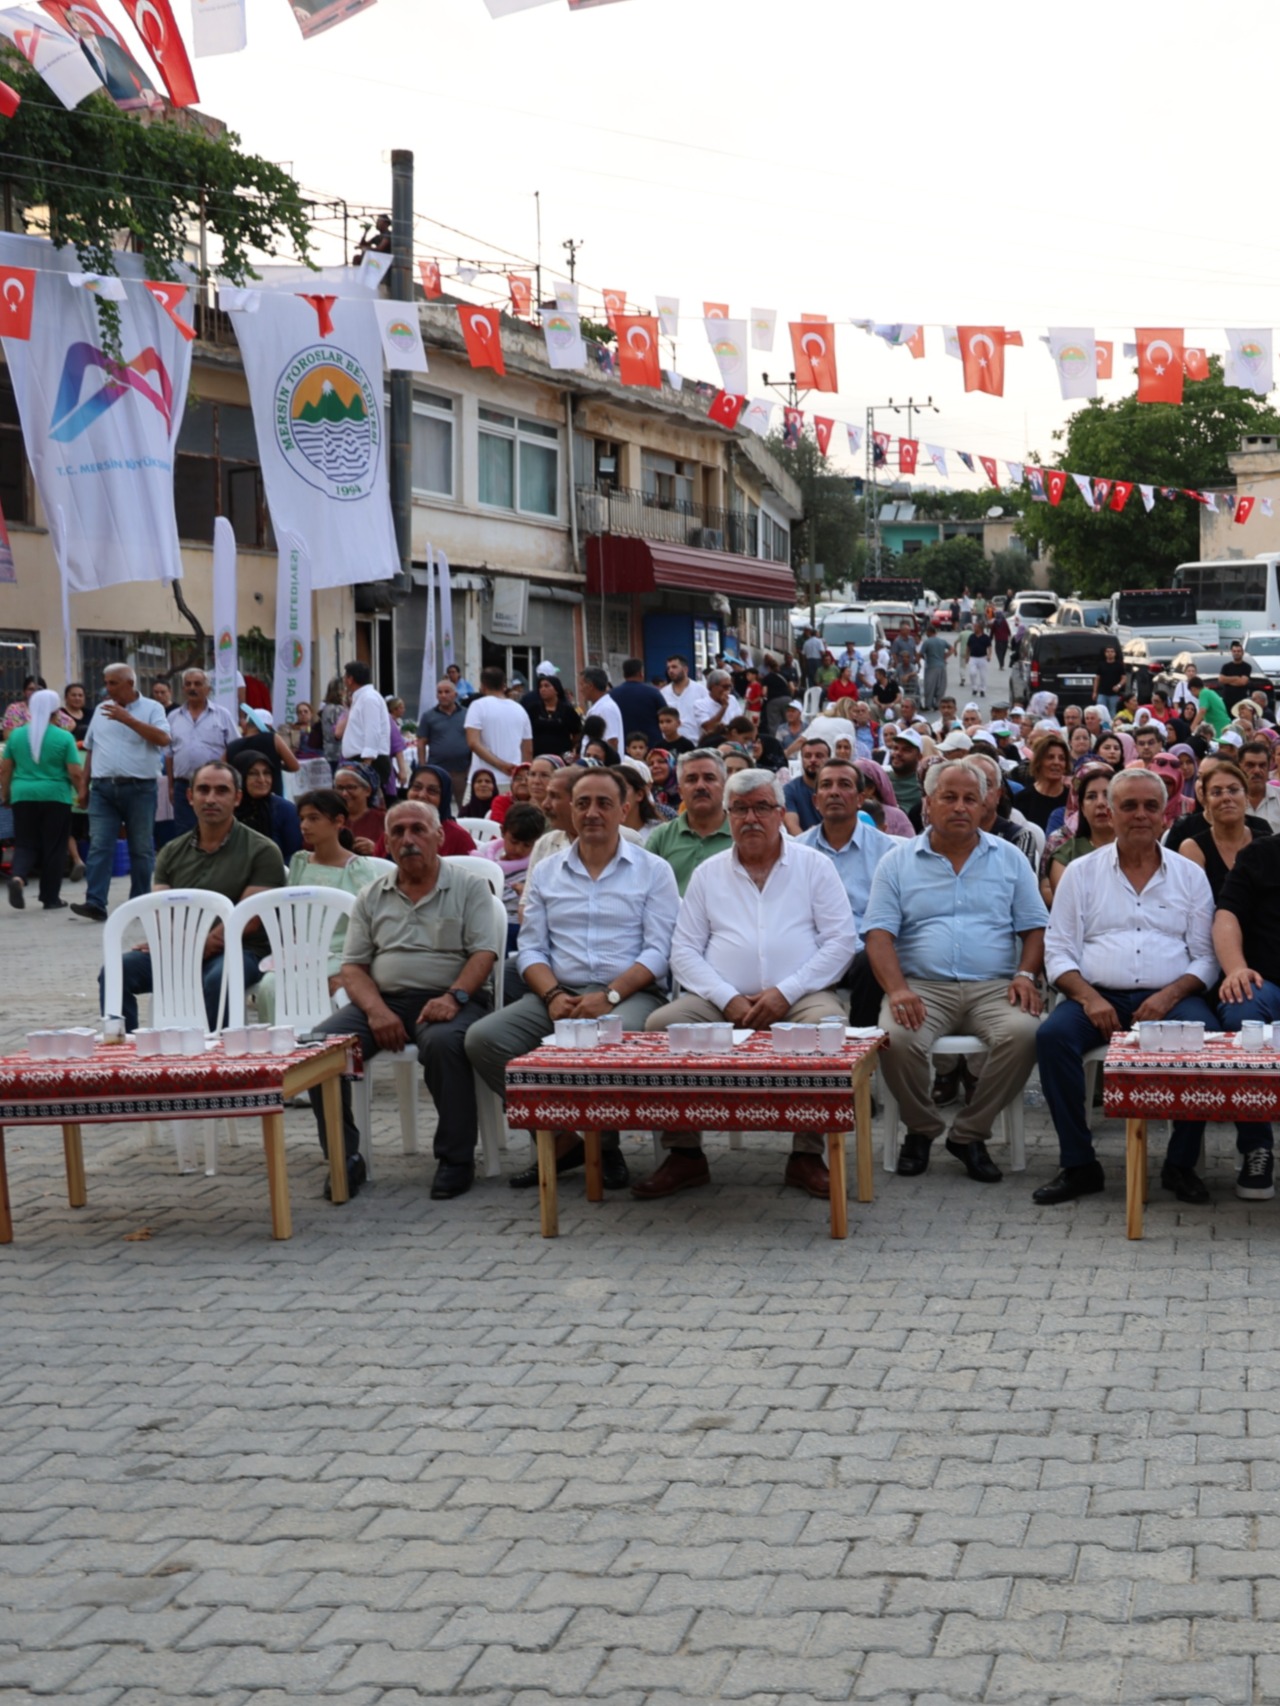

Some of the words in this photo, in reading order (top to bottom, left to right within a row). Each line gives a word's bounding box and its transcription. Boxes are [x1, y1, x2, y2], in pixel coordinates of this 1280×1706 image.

[277, 386, 295, 451] MERSİN
[286, 349, 344, 385] TOROSLAR
[80, 457, 123, 474] MERSİN
[335, 484, 362, 497] 1994
